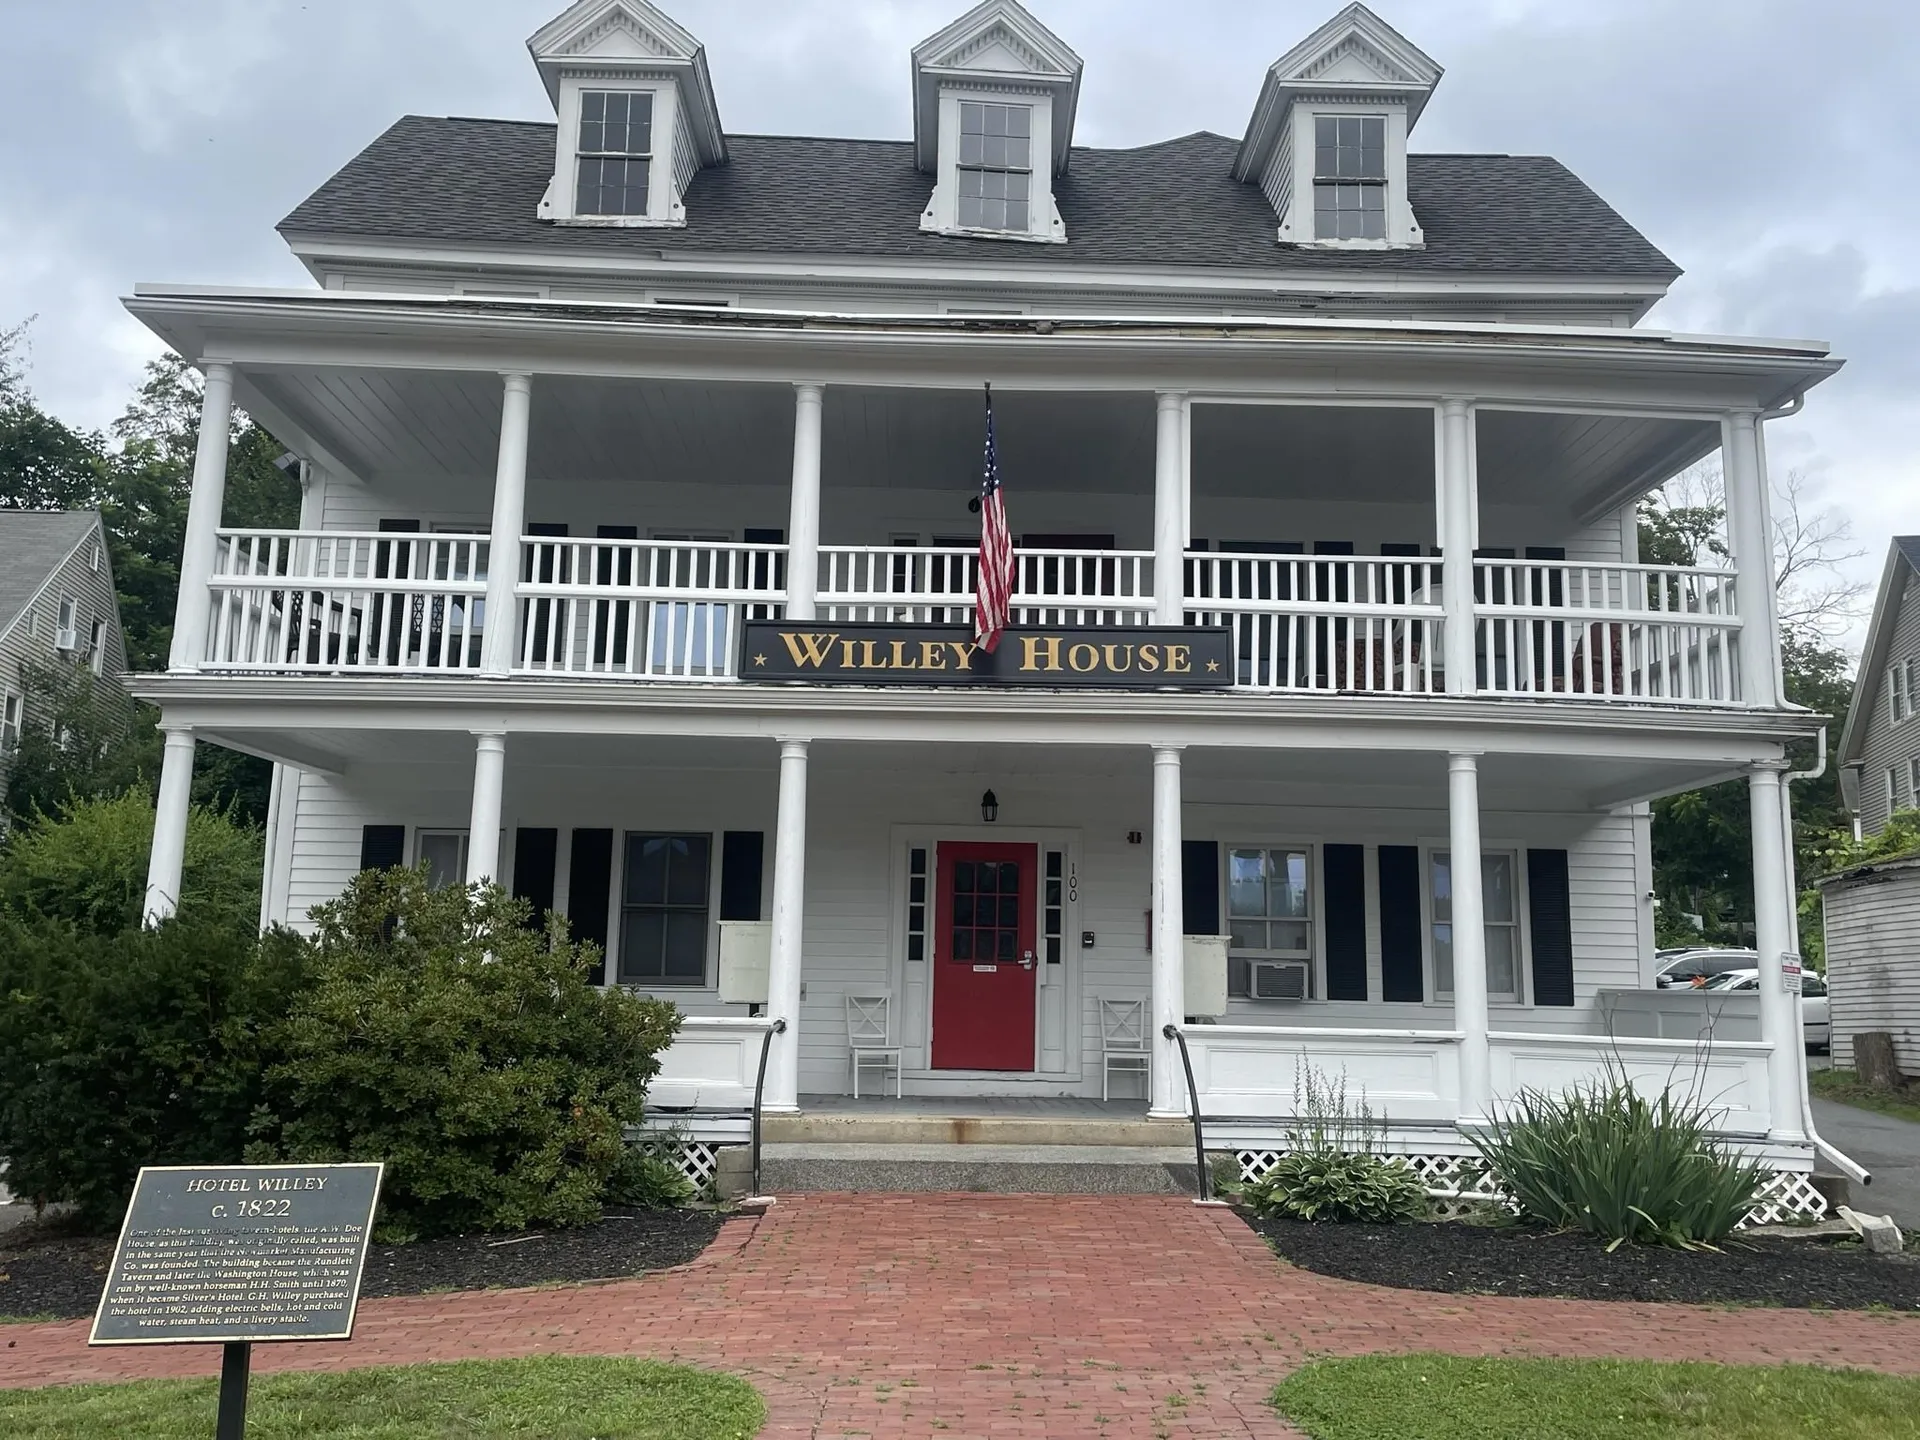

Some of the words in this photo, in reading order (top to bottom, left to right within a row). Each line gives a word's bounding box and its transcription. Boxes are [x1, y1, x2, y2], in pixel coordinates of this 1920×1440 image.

[778, 633, 978, 670] WILLEY
[1019, 636, 1192, 673] HOUSE
[1069, 862, 1077, 902] 100
[186, 1179, 251, 1192] HOTEL
[258, 1177, 328, 1191] WILLEY
[211, 1205, 228, 1218] c.
[236, 1199, 291, 1217] 1822
[130, 1228, 149, 1237] One
[150, 1228, 161, 1237] of
[162, 1227, 176, 1236] the
[178, 1227, 194, 1236] last
[345, 1224, 362, 1233] Doe
[158, 1240, 169, 1248] as
[170, 1238, 186, 1247] this
[290, 1235, 318, 1244] called,
[321, 1236, 338, 1244] was
[340, 1234, 360, 1243] built
[125, 1250, 135, 1259] in
[137, 1250, 152, 1259] the
[153, 1250, 177, 1258] same
[178, 1250, 198, 1260] year
[200, 1248, 218, 1257] that
[220, 1247, 236, 1256] the
[123, 1261, 139, 1270] Co.
[141, 1262, 159, 1270] was
[203, 1259, 220, 1268] The
[222, 1258, 260, 1269] building
[262, 1258, 296, 1267] became
[297, 1257, 312, 1266] the
[314, 1256, 353, 1265] Rundlett
[121, 1273, 153, 1281] Tavern
[154, 1272, 172, 1280] and
[173, 1271, 195, 1280] later
[197, 1270, 211, 1279] the
[214, 1269, 267, 1279] Washington
[303, 1268, 330, 1277] which
[332, 1269, 350, 1277] was
[115, 1285, 132, 1293] run
[134, 1284, 146, 1294] by
[148, 1283, 201, 1292] well-known
[203, 1282, 247, 1291] horseman
[249, 1281, 271, 1289] H.H.
[273, 1280, 300, 1289] Smith
[302, 1280, 324, 1288] until
[326, 1279, 349, 1288] 1870,
[109, 1295, 135, 1304] when
[136, 1294, 145, 1304] it
[146, 1294, 180, 1303] became
[181, 1292, 216, 1302] Silver's
[217, 1292, 245, 1301] Hotel.
[247, 1291, 269, 1300] G.H.
[272, 1291, 302, 1301] Willey
[303, 1290, 350, 1301] purchased
[110, 1306, 126, 1315] the
[127, 1306, 152, 1315] hotel
[153, 1305, 163, 1314] in
[165, 1306, 188, 1315] 1902,
[190, 1304, 223, 1315] adding
[225, 1304, 258, 1313] electric
[260, 1303, 284, 1313] bells,
[287, 1302, 302, 1311] hot
[304, 1302, 321, 1311] and
[323, 1301, 343, 1310] cold
[139, 1318, 167, 1327] water,
[169, 1317, 197, 1326] steam
[199, 1316, 221, 1326] heat,
[223, 1315, 241, 1325] and
[243, 1316, 249, 1324] a
[251, 1314, 278, 1325] livery
[280, 1313, 310, 1323] stable.
